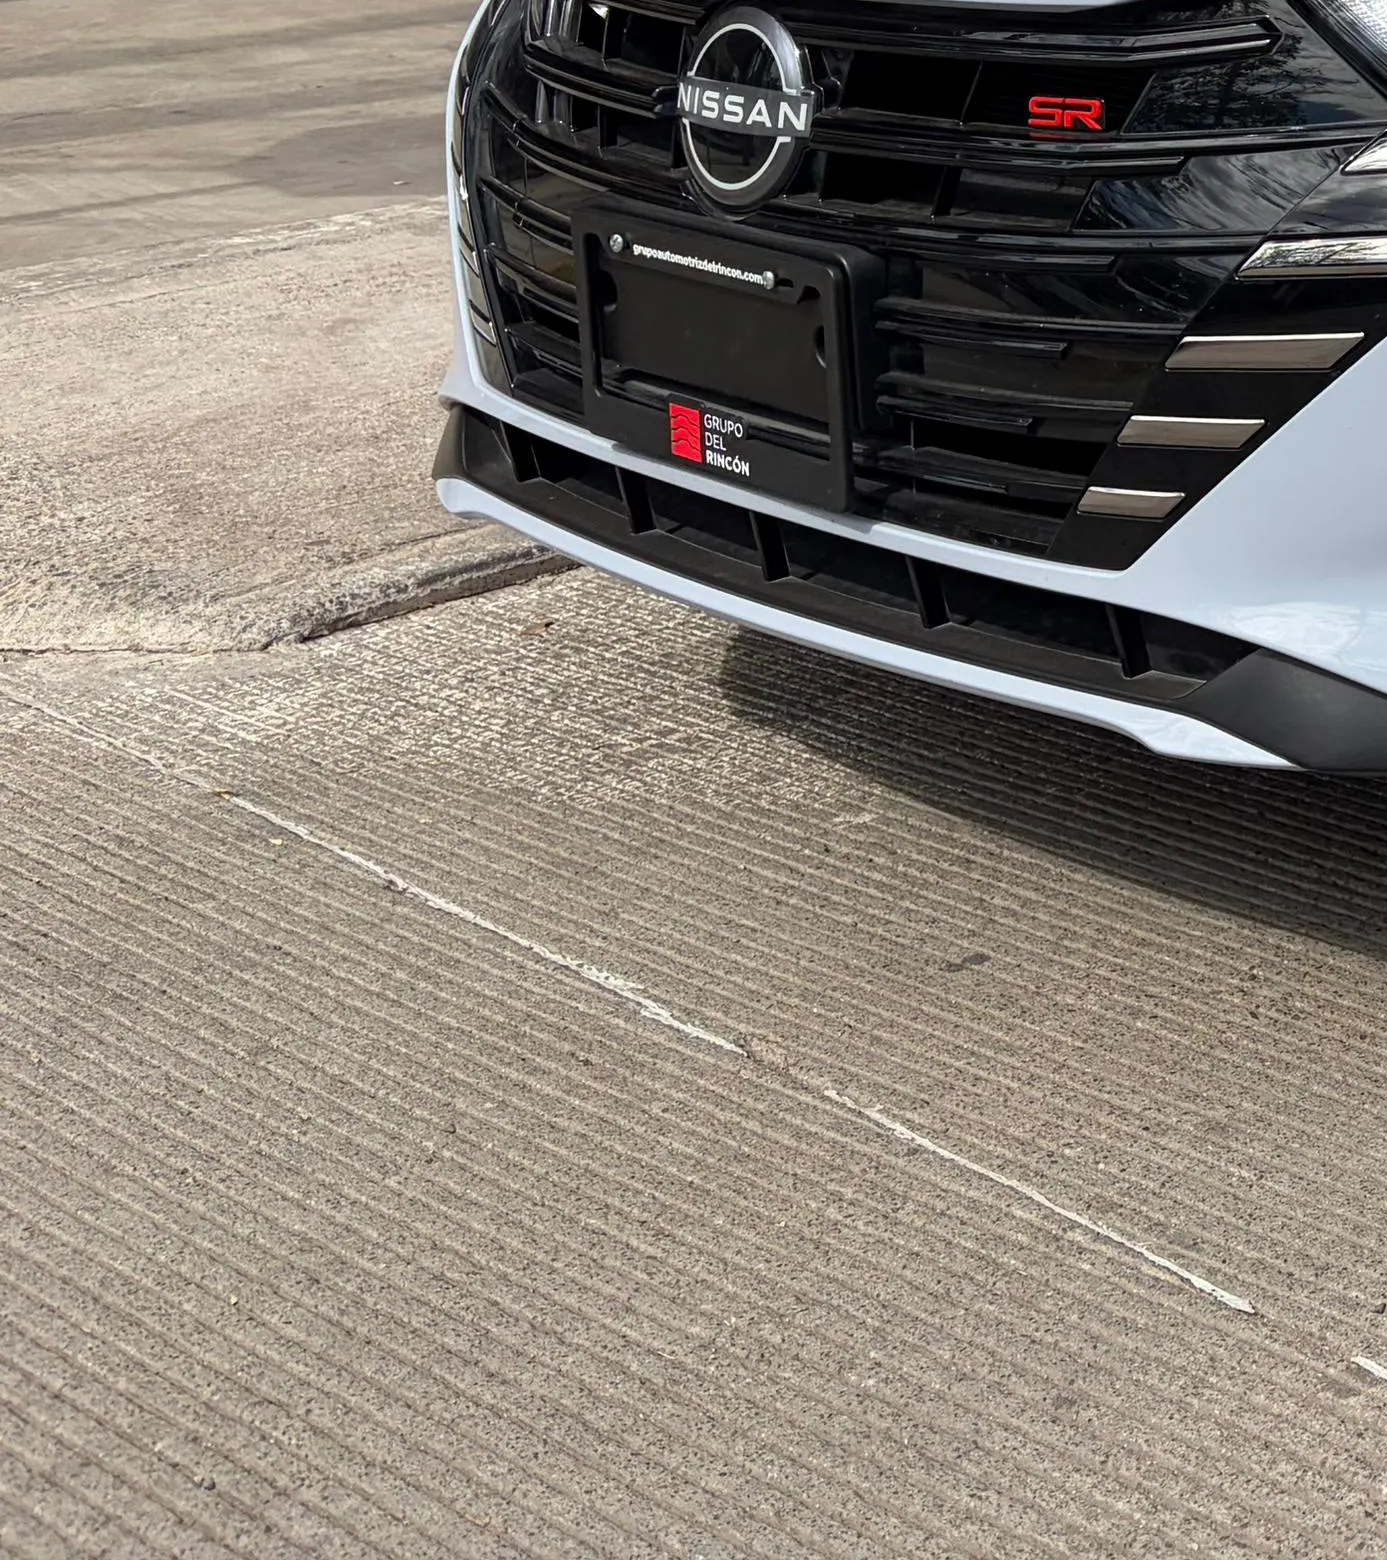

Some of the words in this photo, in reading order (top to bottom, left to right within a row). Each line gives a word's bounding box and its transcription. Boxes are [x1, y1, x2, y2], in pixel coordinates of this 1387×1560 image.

[676, 82, 809, 132] NISSAN
[1028, 96, 1104, 130] SR
[704, 414, 743, 438] GRUPO
[705, 431, 727, 451] DEL
[706, 449, 750, 476] RINCÓN
